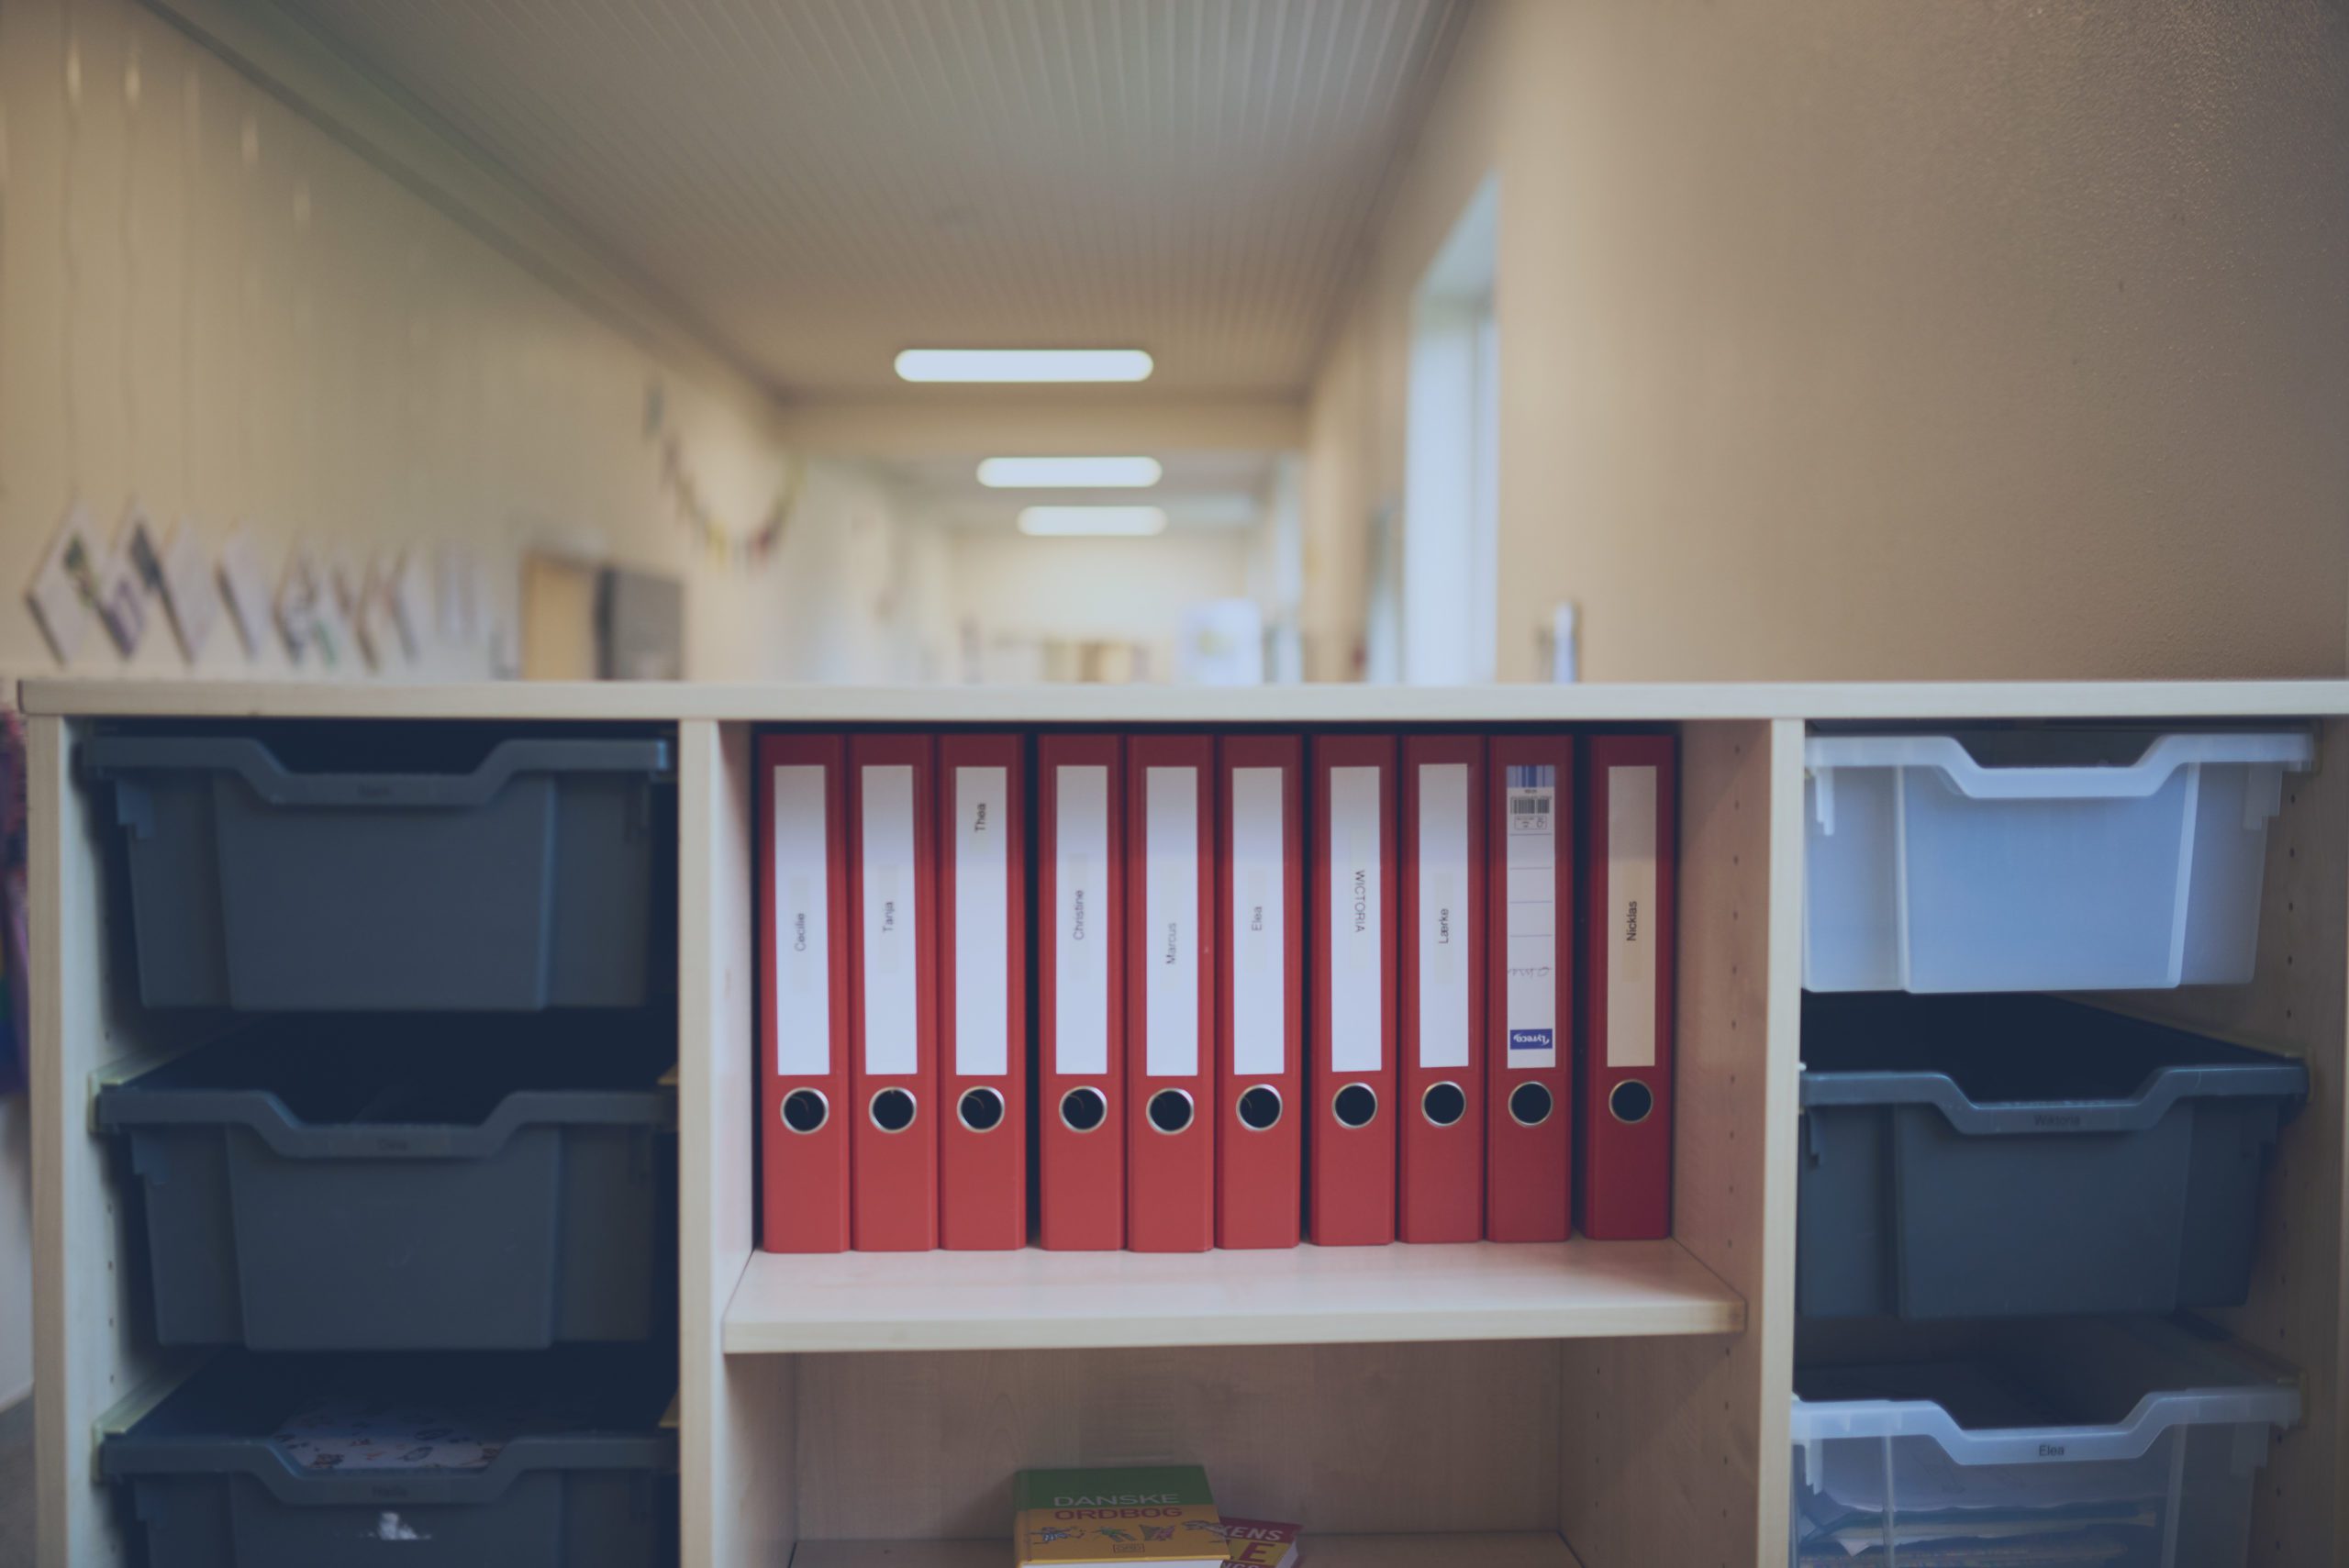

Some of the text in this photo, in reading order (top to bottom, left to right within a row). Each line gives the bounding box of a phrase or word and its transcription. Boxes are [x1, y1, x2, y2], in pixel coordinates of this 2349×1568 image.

[974, 802, 986, 833] Thea
[883, 901, 895, 932] Tanja
[1073, 889, 1085, 940] Christine
[1354, 870, 1365, 932] WICTORIA
[795, 912, 807, 951] Cecilie
[1252, 906, 1263, 931] Elea
[1439, 908, 1450, 944] Lærke
[1626, 900, 1638, 941] Nicklas
[1166, 922, 1177, 964] Marcus
[1512, 1033, 1551, 1046] Lyreco
[2039, 1444, 2065, 1457] Elea
[1054, 1494, 1180, 1507] DANSKE
[1054, 1507, 1183, 1521] ORDBOG
